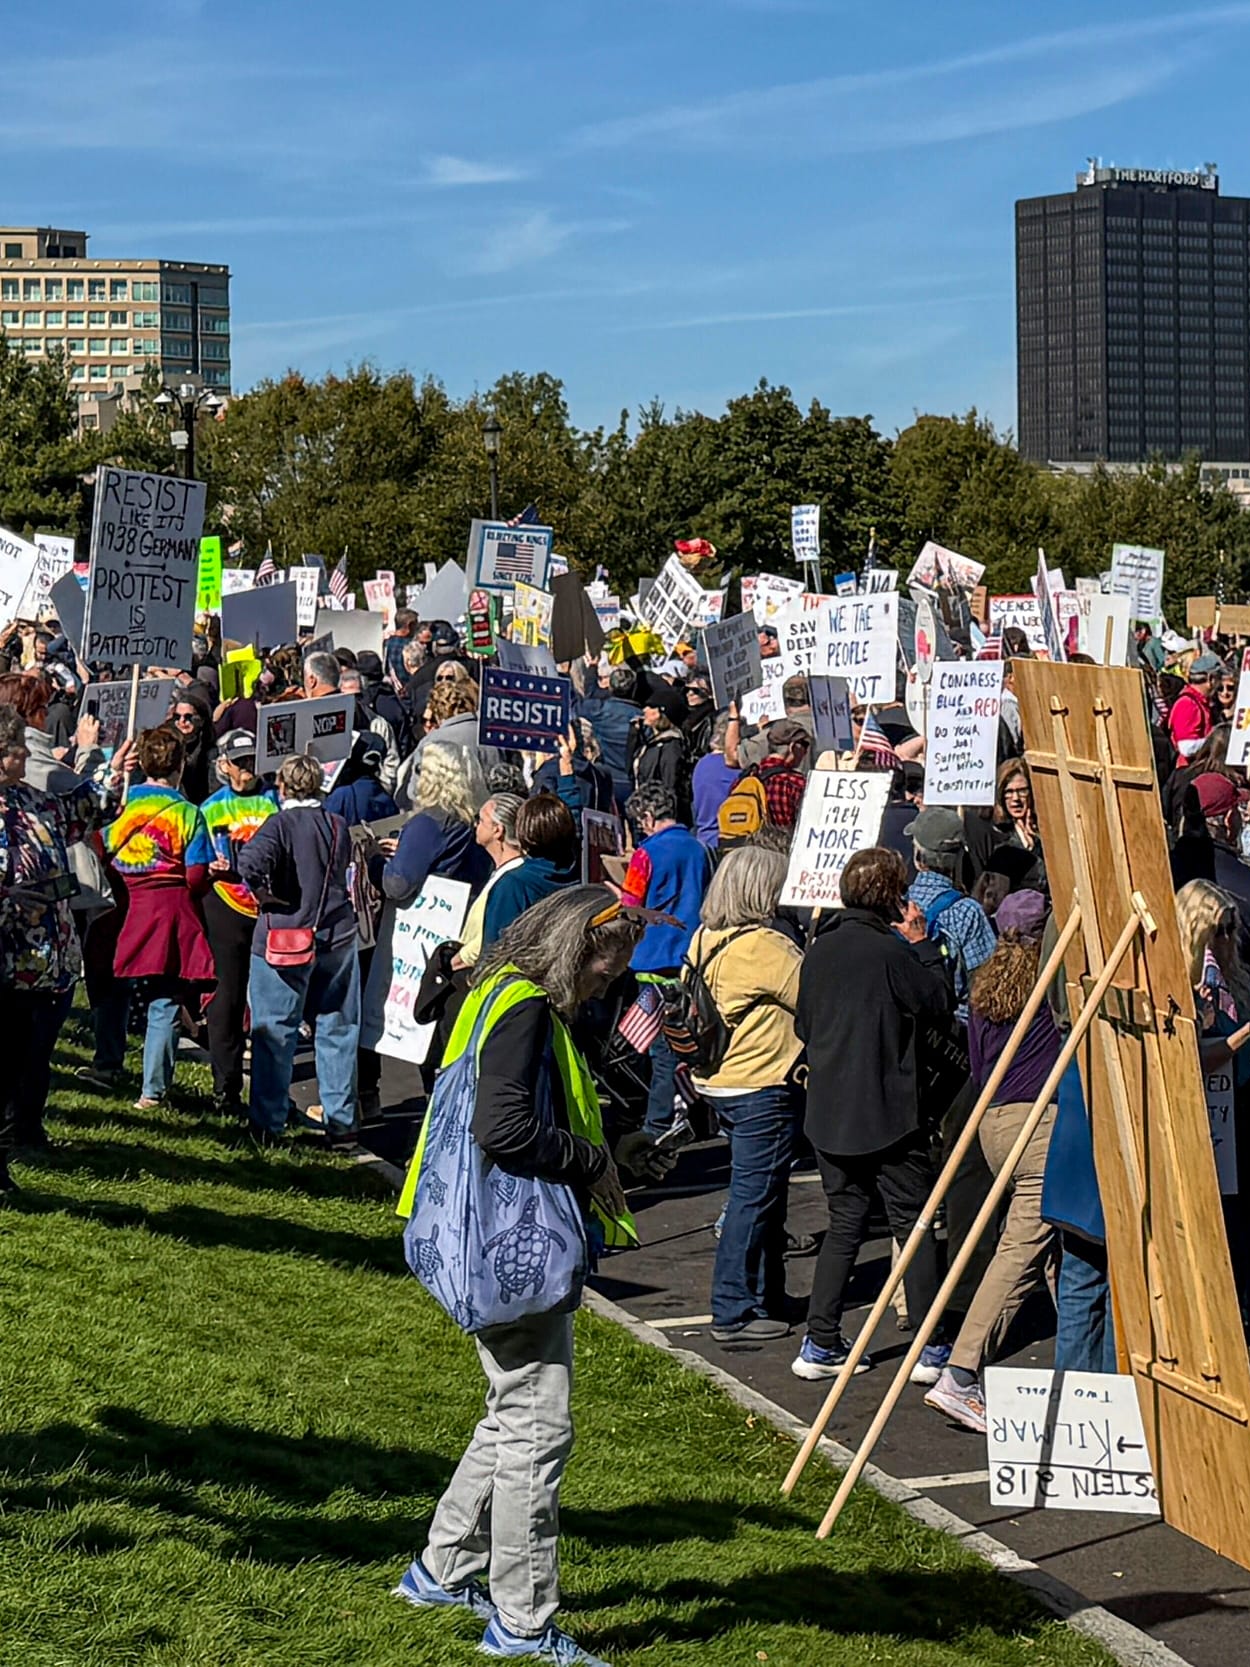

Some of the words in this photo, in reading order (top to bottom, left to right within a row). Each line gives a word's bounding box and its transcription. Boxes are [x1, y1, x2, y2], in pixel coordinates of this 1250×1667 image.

[1114, 168, 1136, 181] THE
[1138, 169, 1199, 186] HARTFORD
[103, 471, 197, 515] RESIST
[120, 507, 151, 528] LIKE
[101, 521, 138, 556] 1938
[93, 566, 189, 609] PROTEST
[130, 604, 146, 626] IS
[993, 600, 1035, 612] SCIENCE
[828, 604, 846, 634] WE
[89, 631, 179, 661] PATRIOTIC
[827, 640, 871, 668] PEOPLE
[486, 697, 562, 727] RESIST!
[937, 693, 965, 710] BLUE
[974, 697, 999, 718] RED
[823, 777, 870, 800] LESS
[825, 805, 860, 826] 1984
[806, 827, 863, 850] MORE
[992, 1417, 1113, 1473] KILMAR
